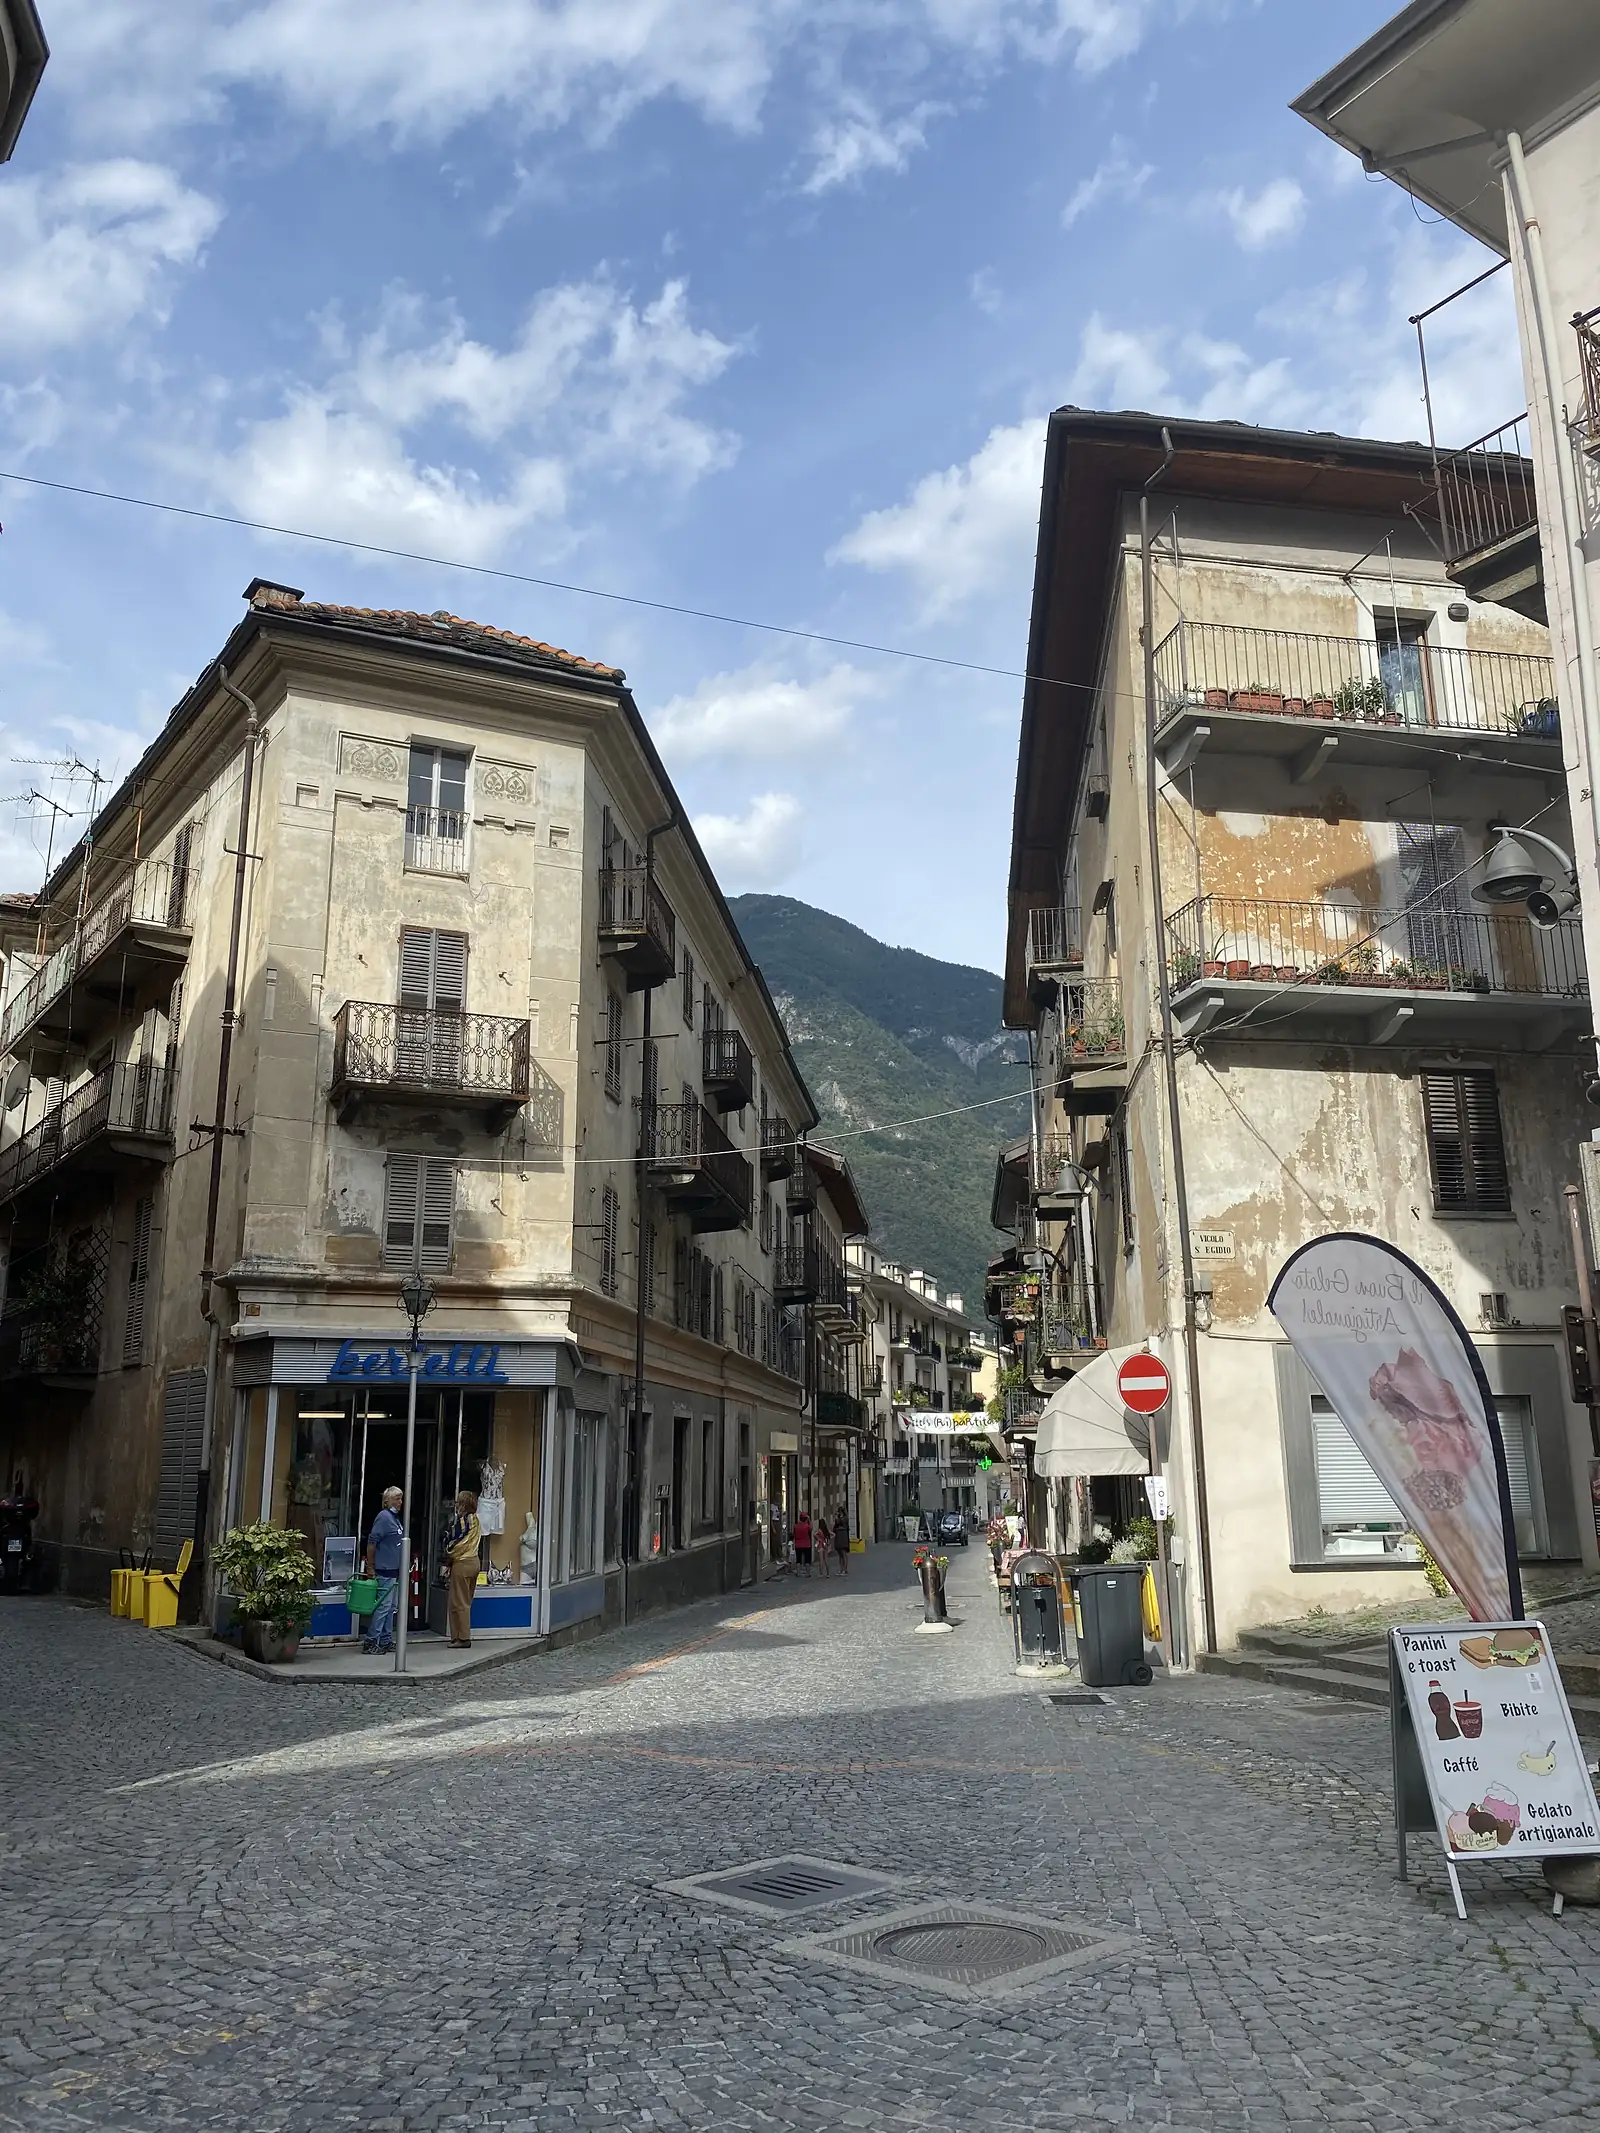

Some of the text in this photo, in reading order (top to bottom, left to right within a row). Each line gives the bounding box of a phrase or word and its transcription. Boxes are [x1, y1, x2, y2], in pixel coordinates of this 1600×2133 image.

[1199, 1234, 1224, 1243] VICOLO
[1205, 1246, 1232, 1254] EGIDIO
[327, 1339, 509, 1383] beretti
[1402, 1635, 1447, 1652] Panini
[1408, 1657, 1457, 1673] e toast
[1500, 1702, 1538, 1717] Bibite
[1527, 1802, 1572, 1819] Gelato
[1518, 1821, 1595, 1843] artigianale
